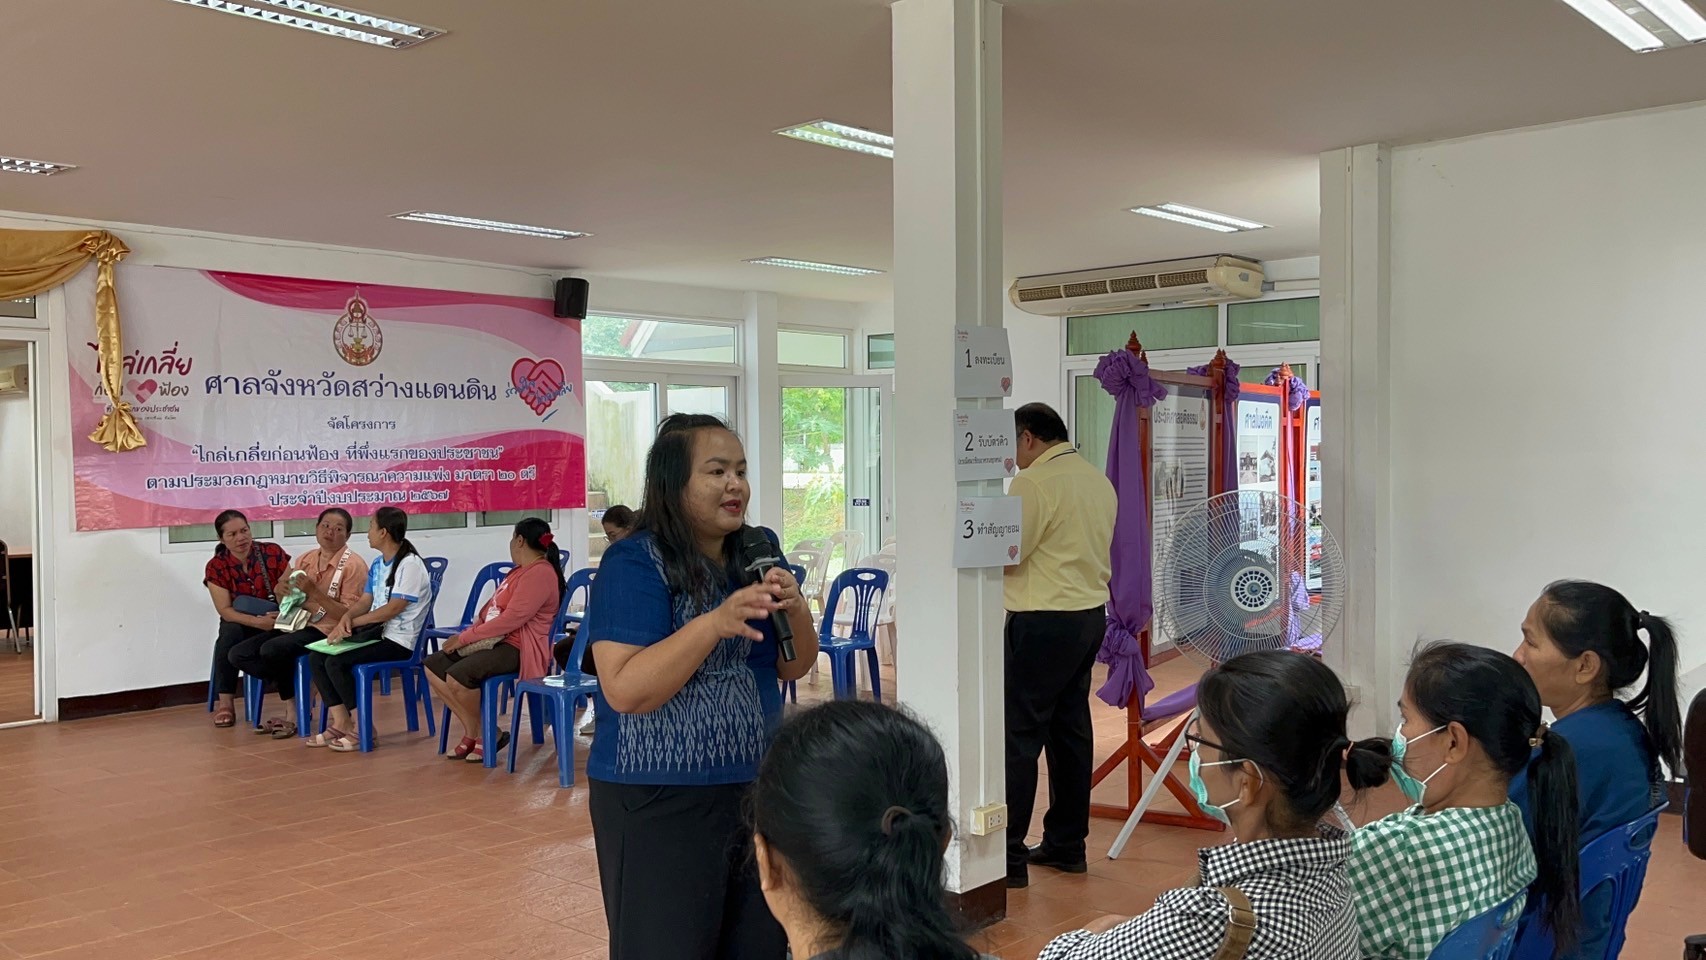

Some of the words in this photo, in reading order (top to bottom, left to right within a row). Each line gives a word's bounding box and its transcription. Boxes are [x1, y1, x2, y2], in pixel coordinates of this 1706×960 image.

[965, 348, 972, 368] 1
[974, 352, 1005, 365] ลงทะเบียน
[158, 381, 189, 397] ฟ้อง
[205, 369, 497, 400] ศาลจังหวัดสว่างแดนดิน
[327, 415, 396, 430] จัดโครงการ
[964, 431, 974, 452] 2
[978, 434, 1009, 448] รับบัตรคิว
[146, 467, 450, 489] ตามประมวลกฎหมายวิธีพิจารณาความแพ่ง
[455, 468, 495, 481] มาตรา
[498, 469, 516, 480] ๒๐
[520, 465, 536, 481] ตรี
[269, 488, 406, 506] ประจำปีงบประมาณ
[410, 488, 449, 502] ๒๕๖๗
[963, 519, 974, 539] 3
[977, 522, 1020, 538] ทำสัญญายอม
